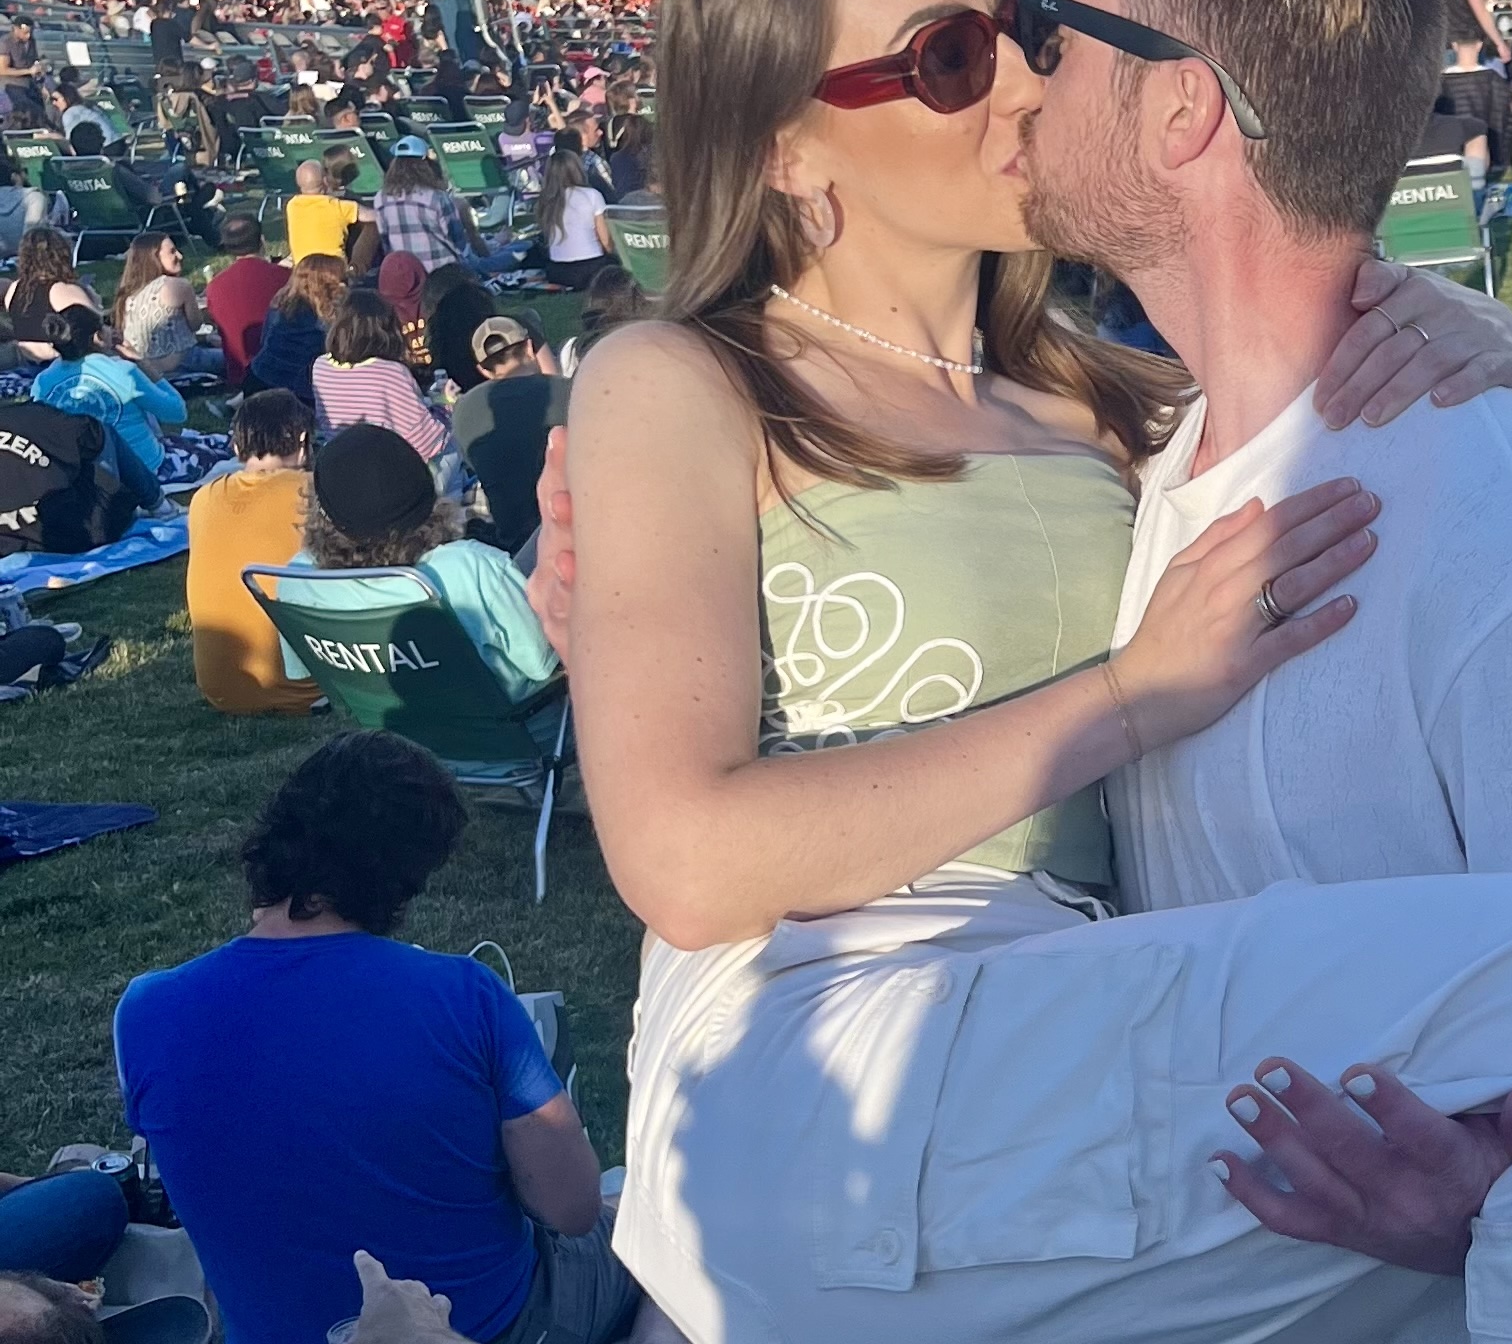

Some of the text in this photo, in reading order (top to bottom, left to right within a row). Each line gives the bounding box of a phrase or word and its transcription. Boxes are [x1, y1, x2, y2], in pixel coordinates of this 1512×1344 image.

[474, 113, 506, 123] RENTA
[17, 145, 52, 158] RENTAL
[442, 140, 485, 153] RENTAL
[68, 177, 111, 192] RENTAL
[1390, 184, 1459, 205] RENTAL
[623, 232, 671, 249] RENTA
[304, 634, 440, 674] RENTAL
